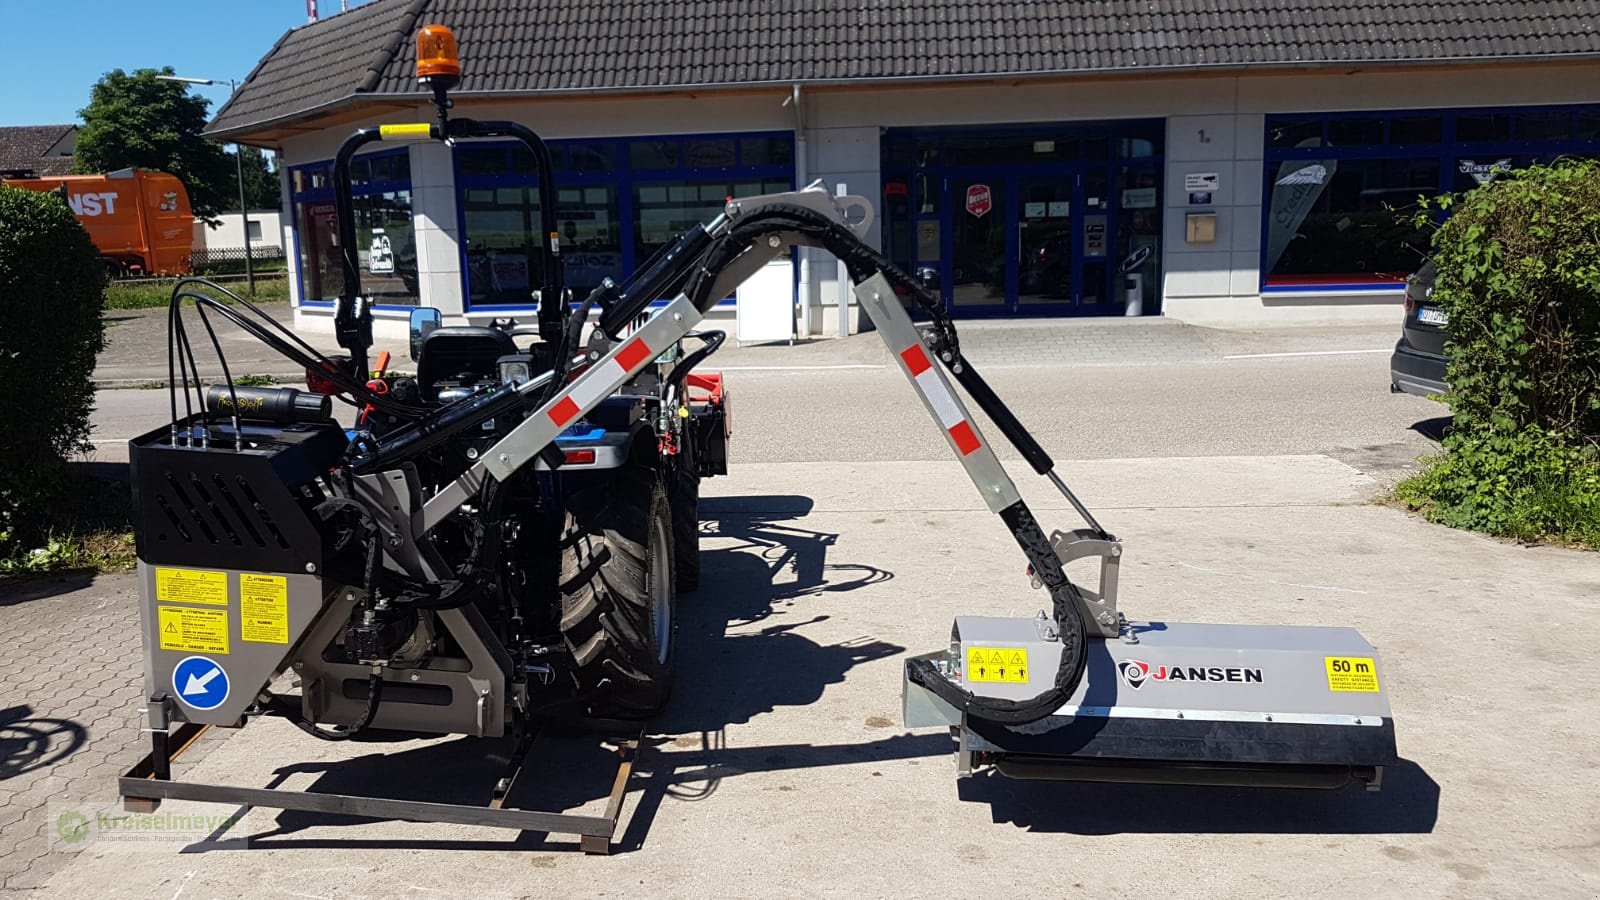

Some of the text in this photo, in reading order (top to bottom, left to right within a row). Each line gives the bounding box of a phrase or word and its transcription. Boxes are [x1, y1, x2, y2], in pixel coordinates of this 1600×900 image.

[1332, 660, 1369, 673] 50 m
[1153, 666, 1263, 683] JANSEN
